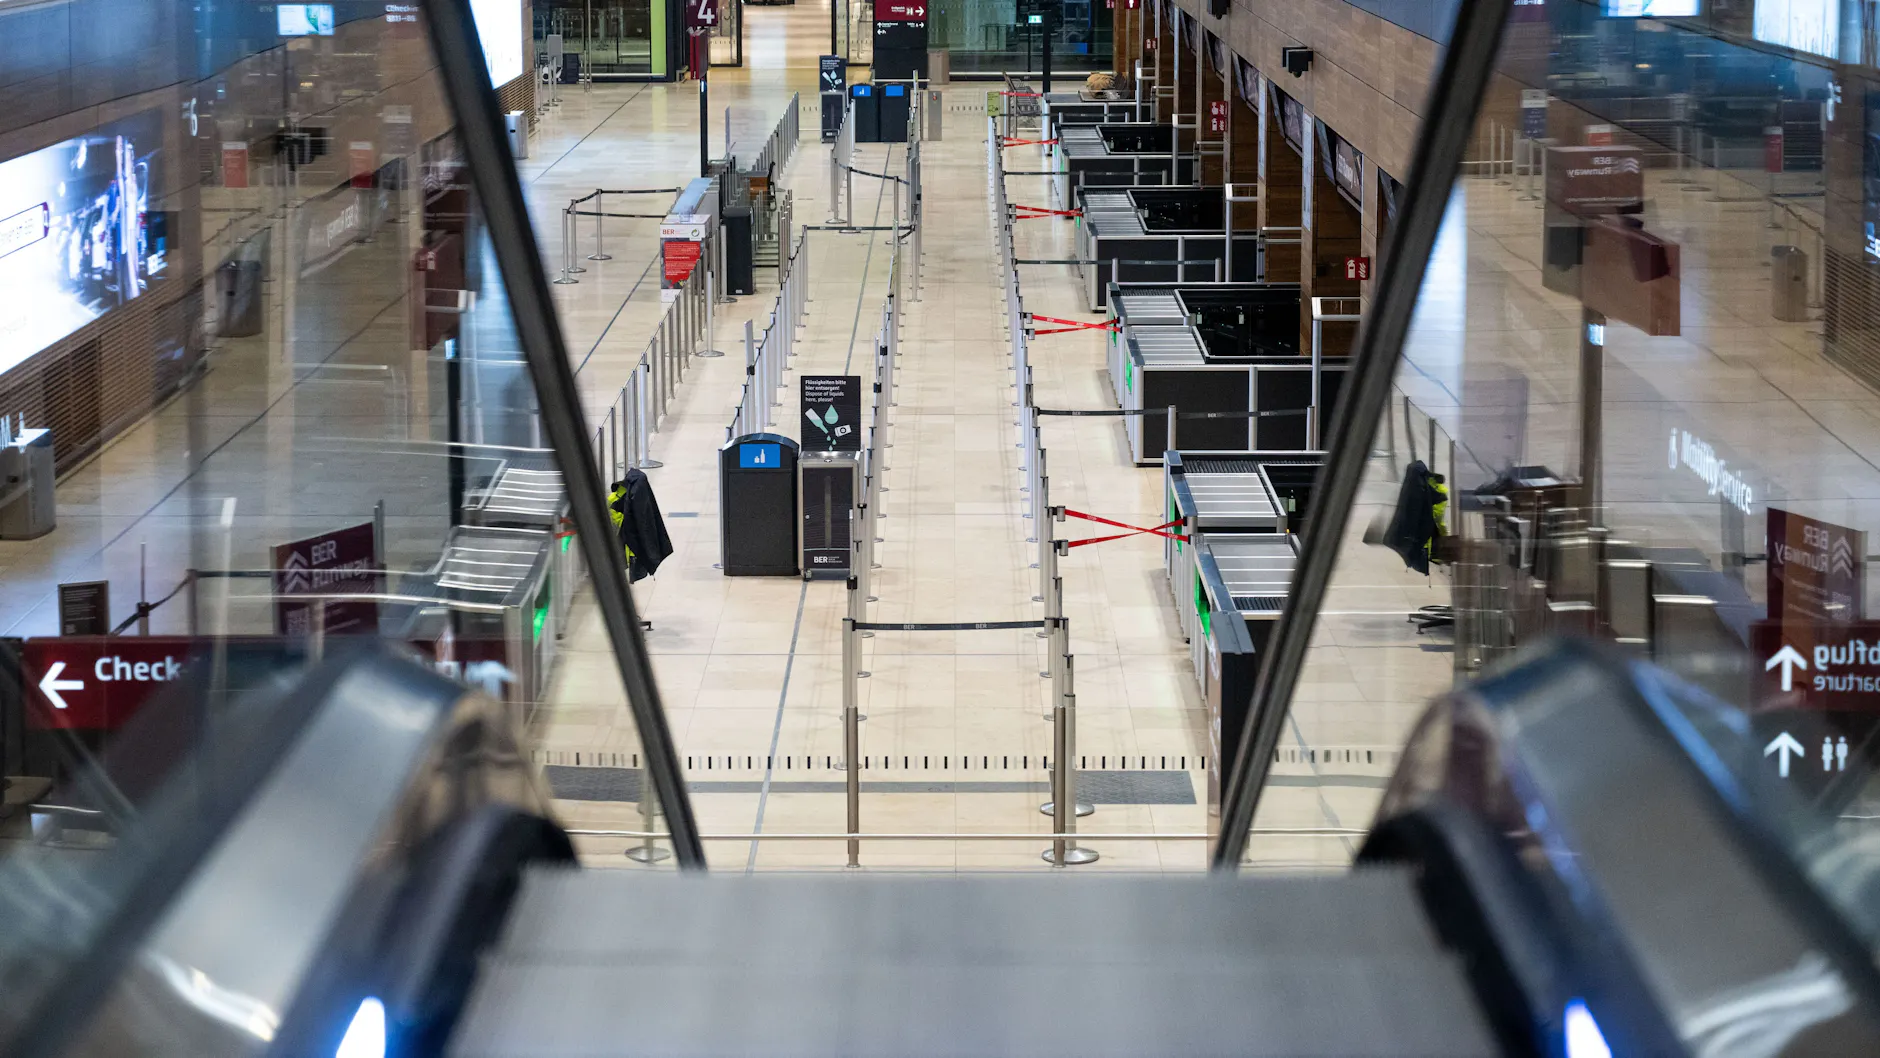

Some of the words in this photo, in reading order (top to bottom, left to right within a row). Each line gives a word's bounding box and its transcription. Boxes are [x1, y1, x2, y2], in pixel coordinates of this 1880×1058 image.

[697, 0, 715, 24] 4
[311, 540, 337, 566] BER
[813, 556, 828, 564] BER
